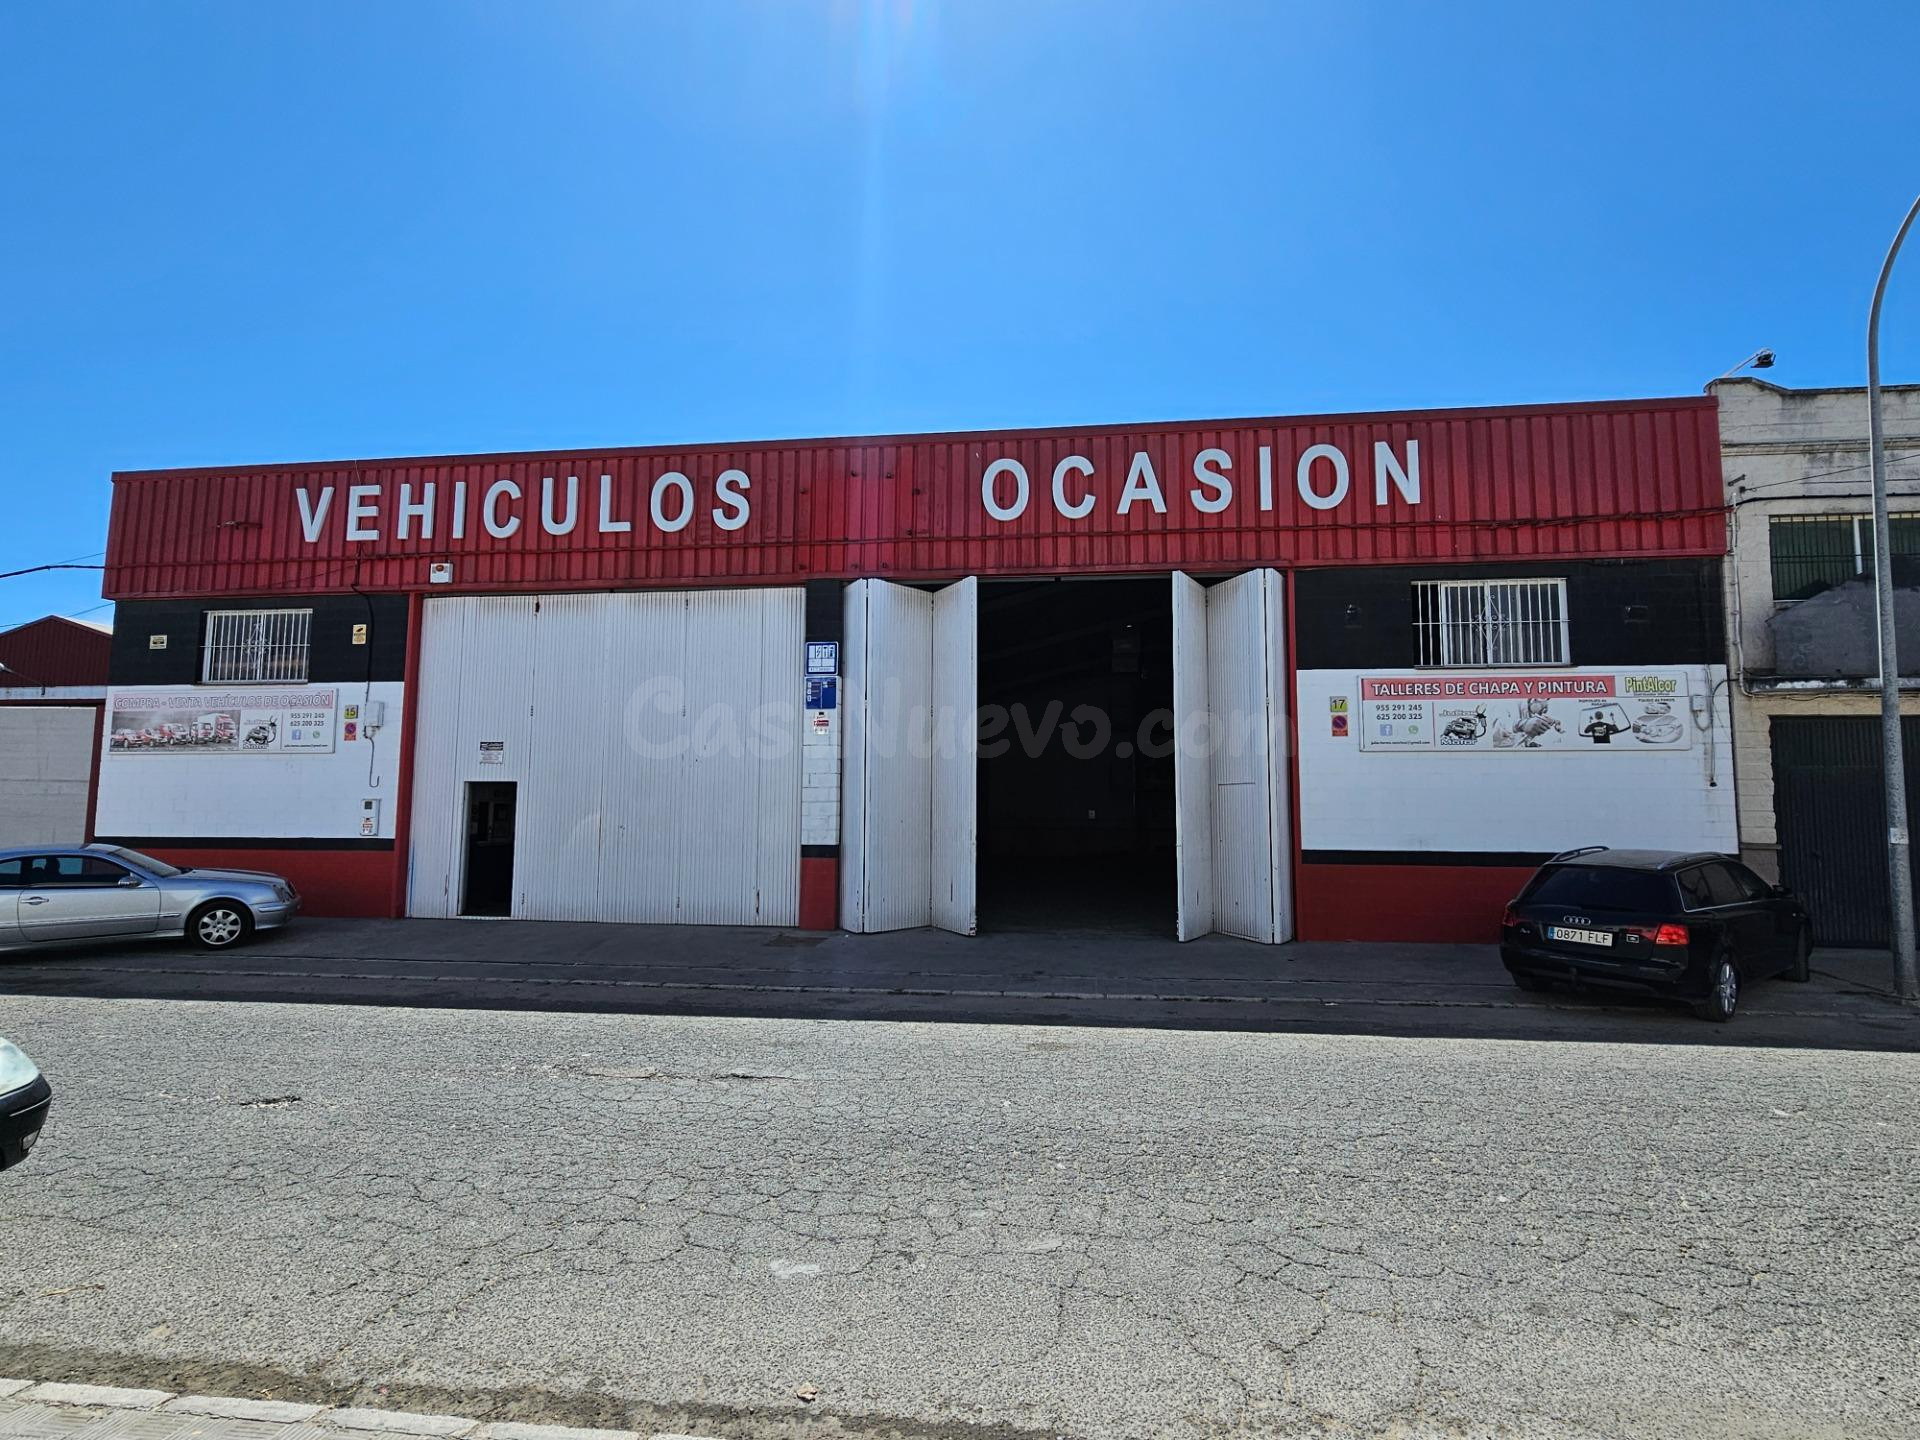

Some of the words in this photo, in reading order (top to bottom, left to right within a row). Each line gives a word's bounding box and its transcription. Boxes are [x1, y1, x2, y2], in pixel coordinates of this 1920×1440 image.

[295, 469, 752, 544] VEHICULOS
[981, 439, 1421, 522] OCASION
[1371, 682, 1440, 697] TALLERES
[1449, 682, 1465, 696] DE
[1469, 681, 1521, 695] CHAPA
[1525, 681, 1535, 694] Y
[1538, 680, 1608, 694] PINTURA
[1624, 675, 1677, 694] PintAlcor
[114, 696, 160, 710] COMPRA
[169, 695, 202, 709] VENTA
[263, 694, 280, 707] DE
[1332, 698, 1346, 710] 17
[1376, 713, 1390, 721] 625
[1556, 929, 1584, 941] 0871
[1587, 931, 1610, 945] FLF
